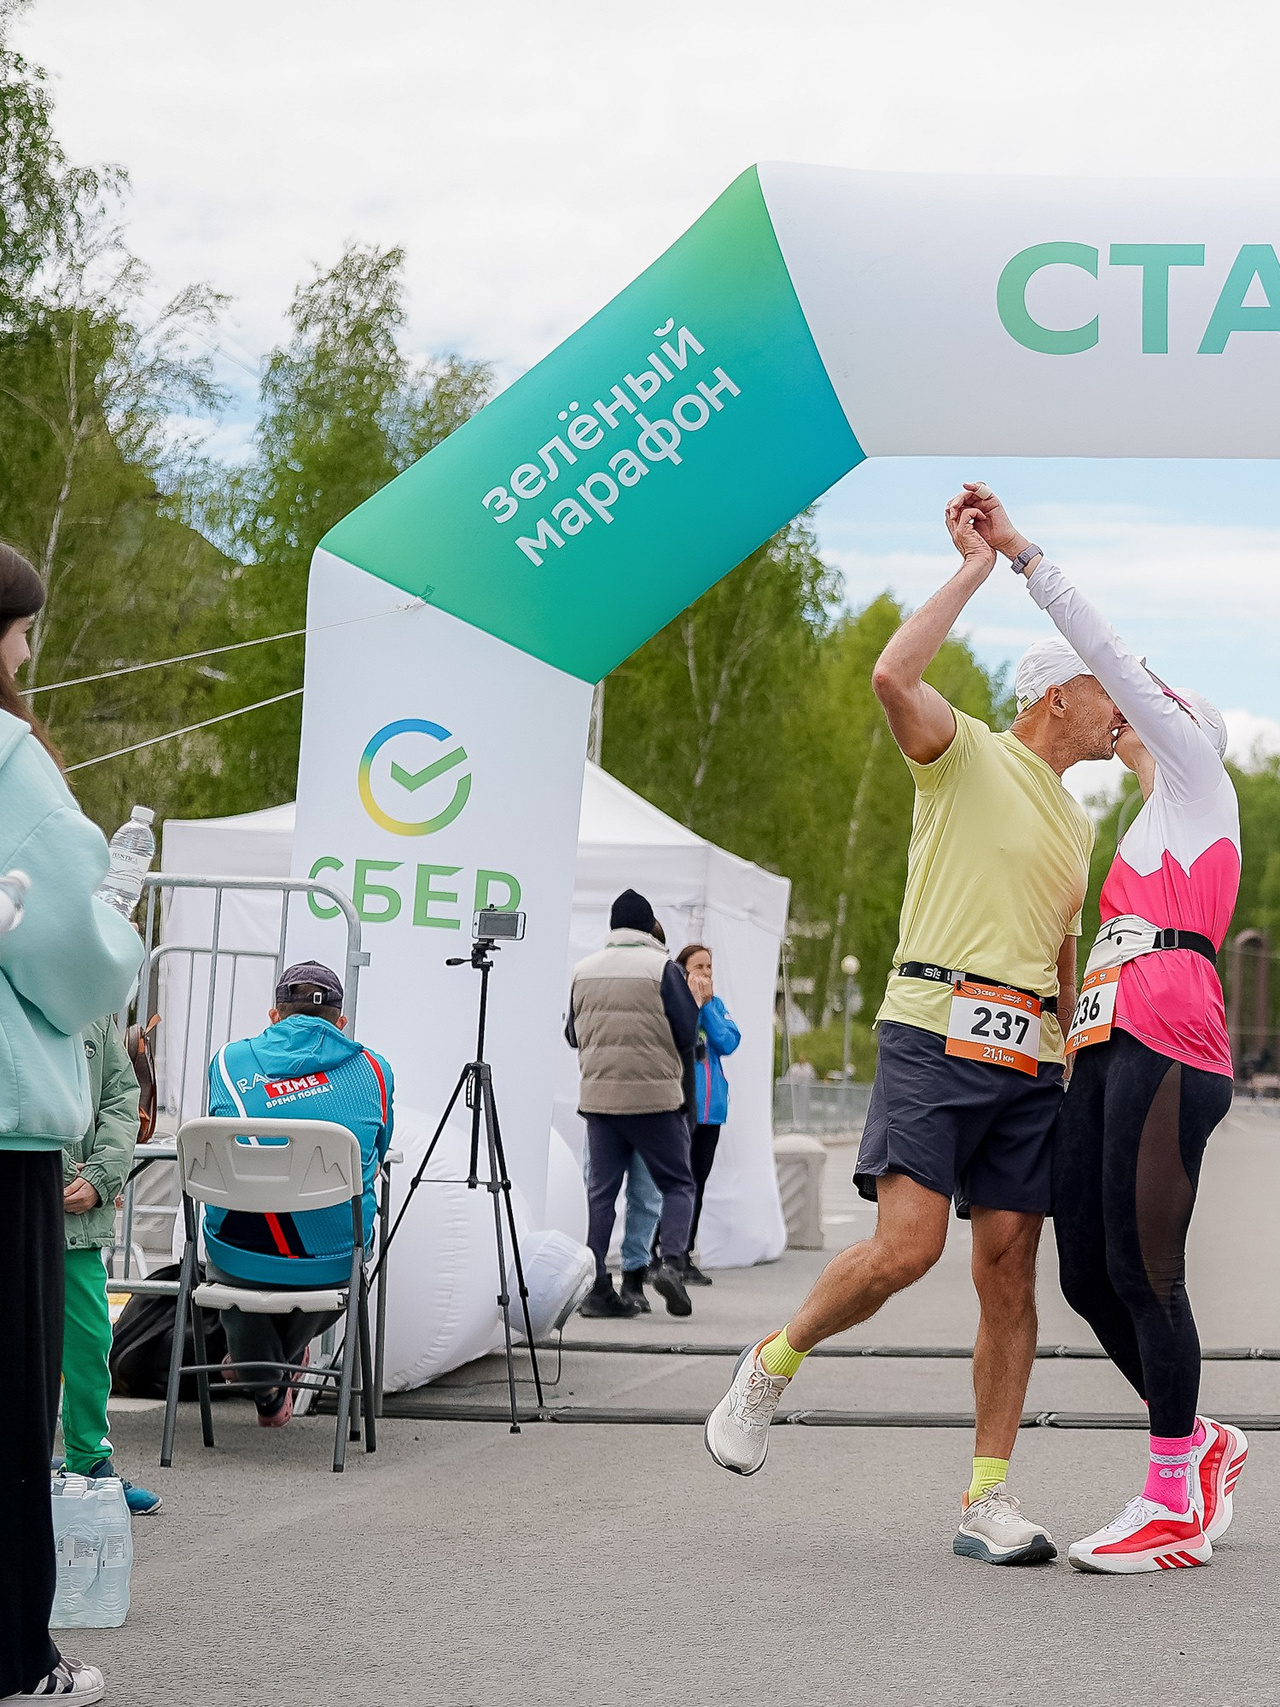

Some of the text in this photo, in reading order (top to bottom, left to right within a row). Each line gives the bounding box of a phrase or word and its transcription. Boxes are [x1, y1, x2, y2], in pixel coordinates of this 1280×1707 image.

[481, 316, 706, 524] зелёный
[514, 366, 742, 568] марафон
[306, 856, 522, 931] СБЕР
[971, 1006, 1030, 1045] 237
[982, 1046, 1002, 1062] 21,1
[265, 1095, 297, 1109] ВРЕМЯ
[272, 1075, 320, 1095] TIME
